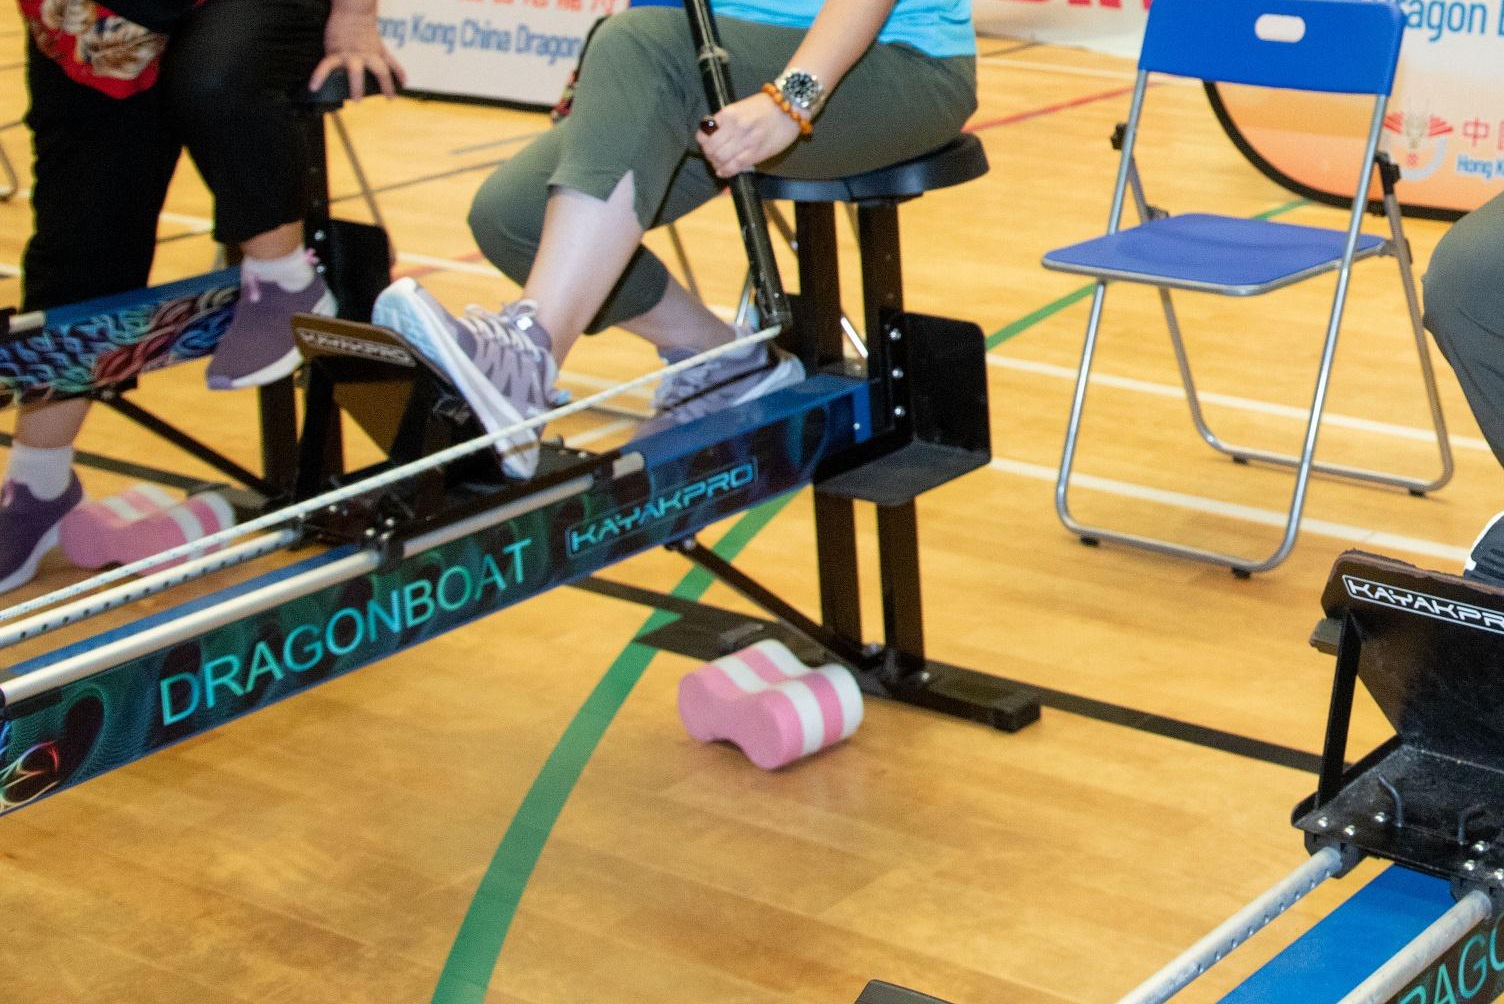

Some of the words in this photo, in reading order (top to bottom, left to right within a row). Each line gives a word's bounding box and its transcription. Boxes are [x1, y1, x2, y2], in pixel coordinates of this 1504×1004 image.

[379, 16, 407, 48] ong
[411, 15, 457, 54] Kong
[460, 17, 511, 52] China
[1456, 154, 1493, 180] Hong
[160, 537, 533, 726] DRAGONBOAT
[571, 461, 755, 552] KAYAKPRO
